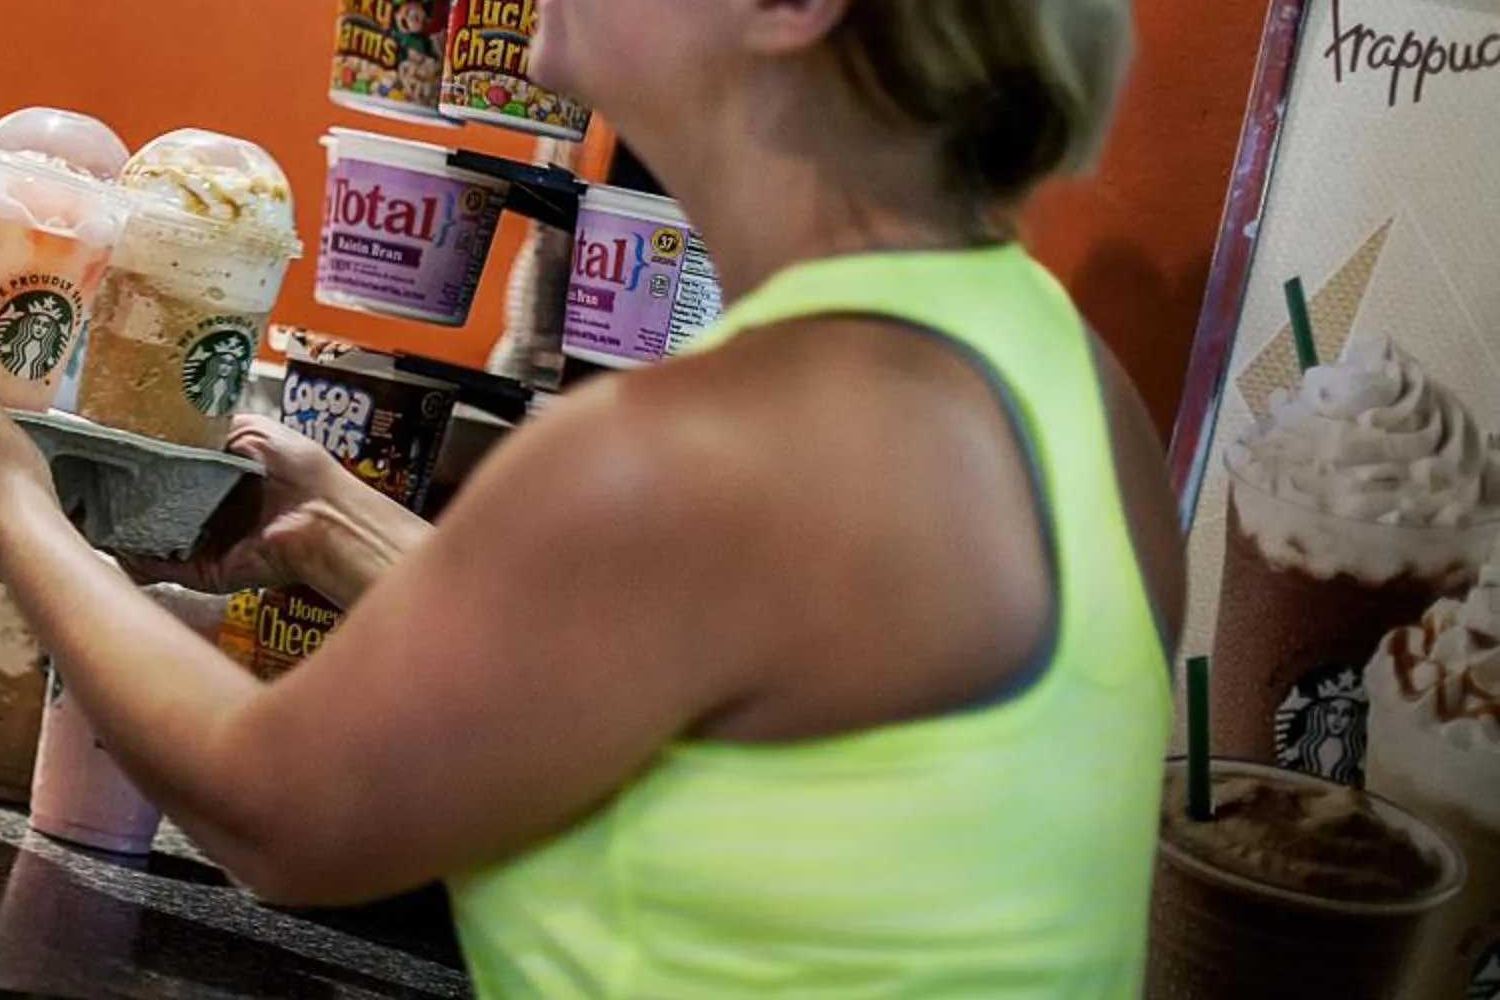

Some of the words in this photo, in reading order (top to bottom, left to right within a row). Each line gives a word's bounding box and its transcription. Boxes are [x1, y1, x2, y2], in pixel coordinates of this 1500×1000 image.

[339, 22, 398, 68] arms
[451, 27, 530, 75] Char
[333, 178, 438, 242] Total
[9, 274, 74, 291] PROUDLY
[573, 229, 628, 286] tal
[283, 371, 373, 426] Cocoa
[259, 604, 322, 657] Chee
